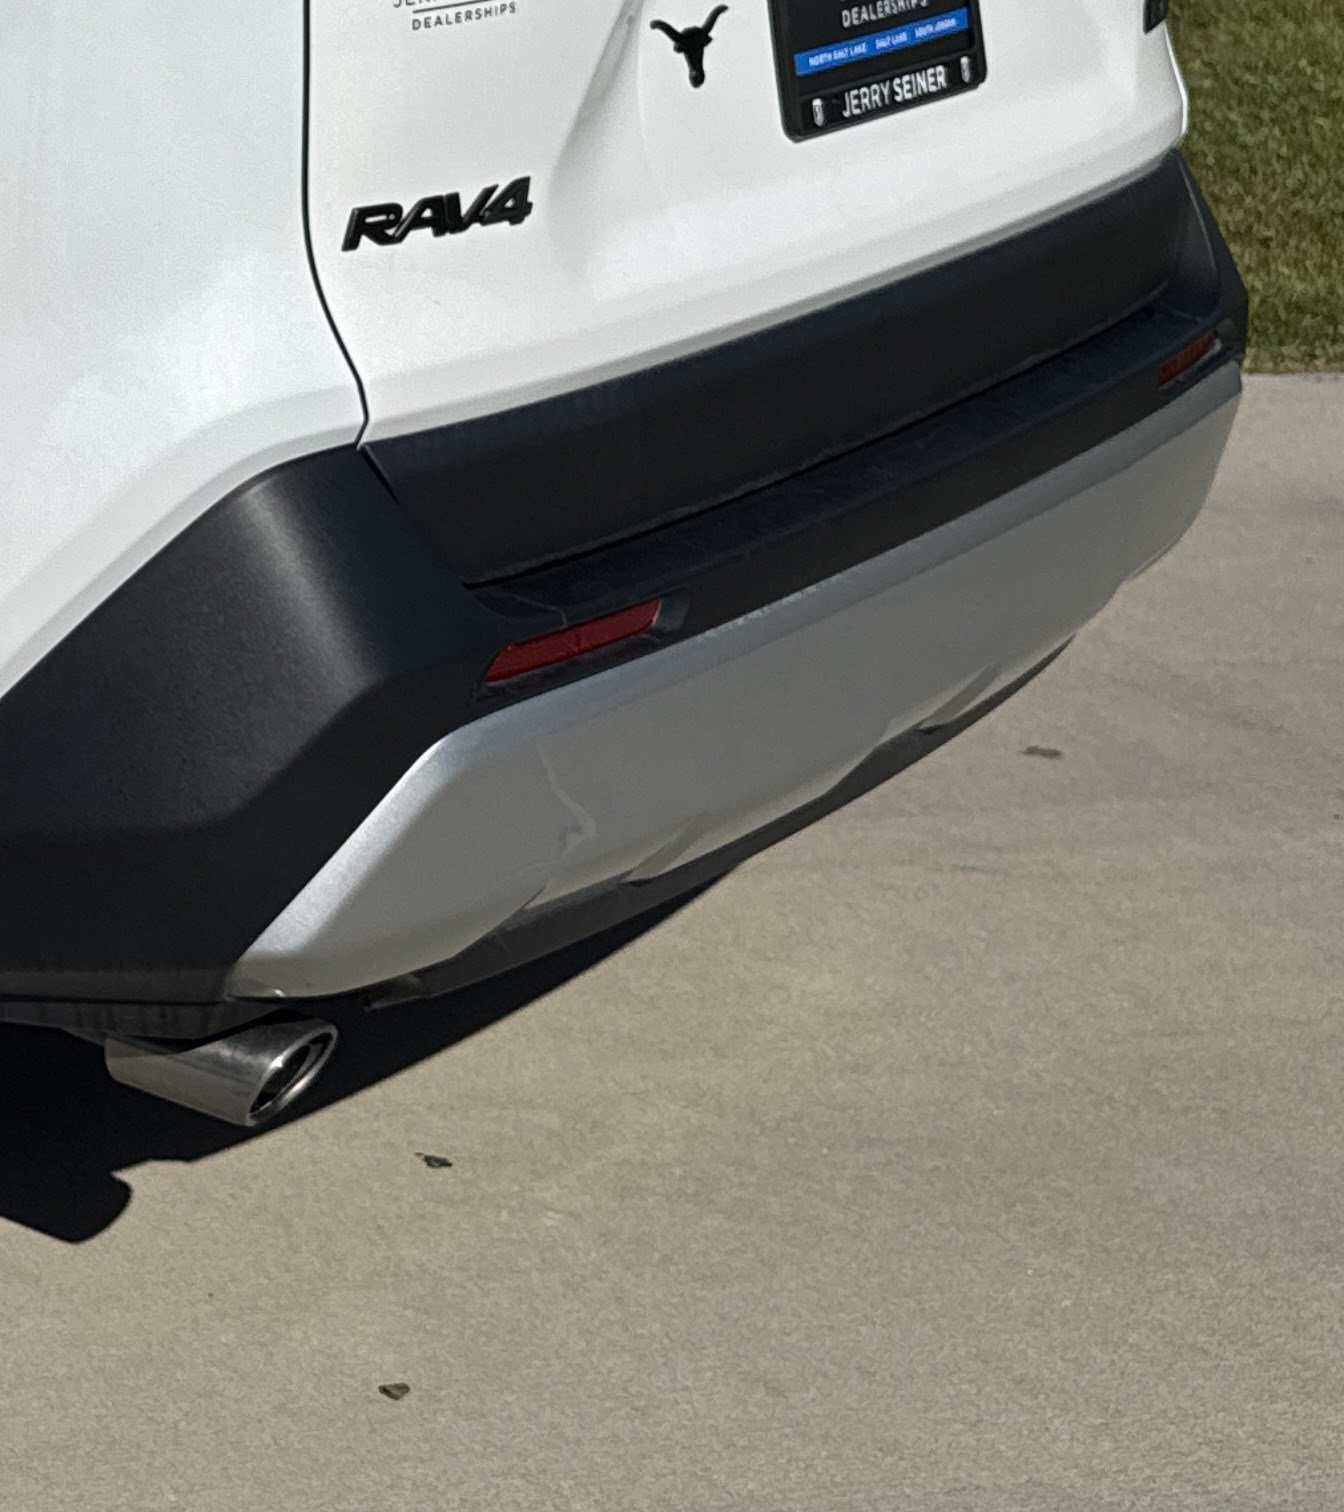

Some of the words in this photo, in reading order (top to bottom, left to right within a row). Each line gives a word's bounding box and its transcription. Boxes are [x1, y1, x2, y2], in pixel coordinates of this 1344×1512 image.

[412, 1, 517, 31] DEALERSHIPS
[842, 80, 891, 118] JERRY
[893, 65, 947, 102] SEINER
[341, 175, 534, 252] RAV4
